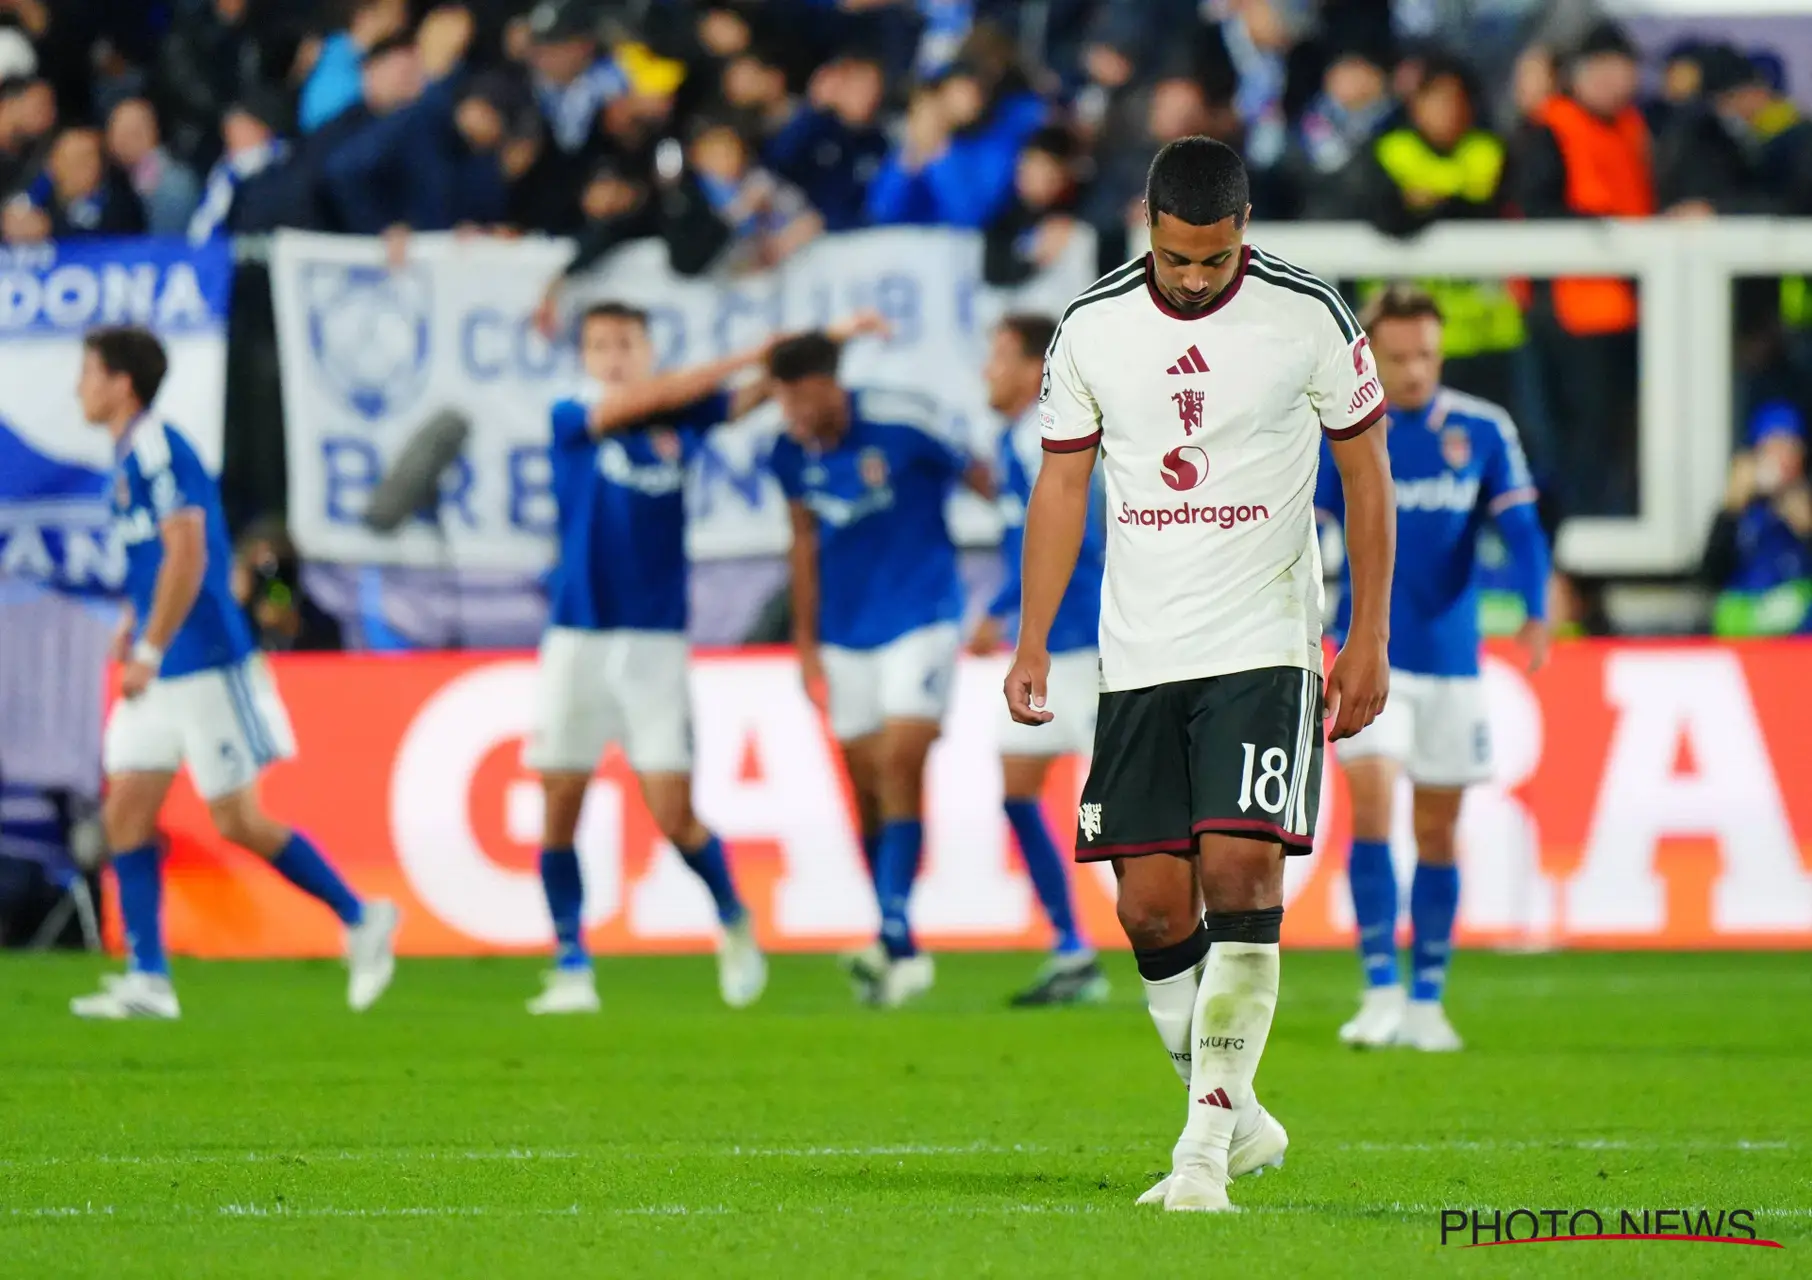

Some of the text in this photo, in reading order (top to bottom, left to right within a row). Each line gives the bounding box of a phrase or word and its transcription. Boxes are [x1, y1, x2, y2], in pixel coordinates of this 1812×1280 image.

[1118, 501, 1269, 531] Snapdragon
[1237, 742, 1289, 814] 18
[1199, 1036, 1244, 1051] MUFC
